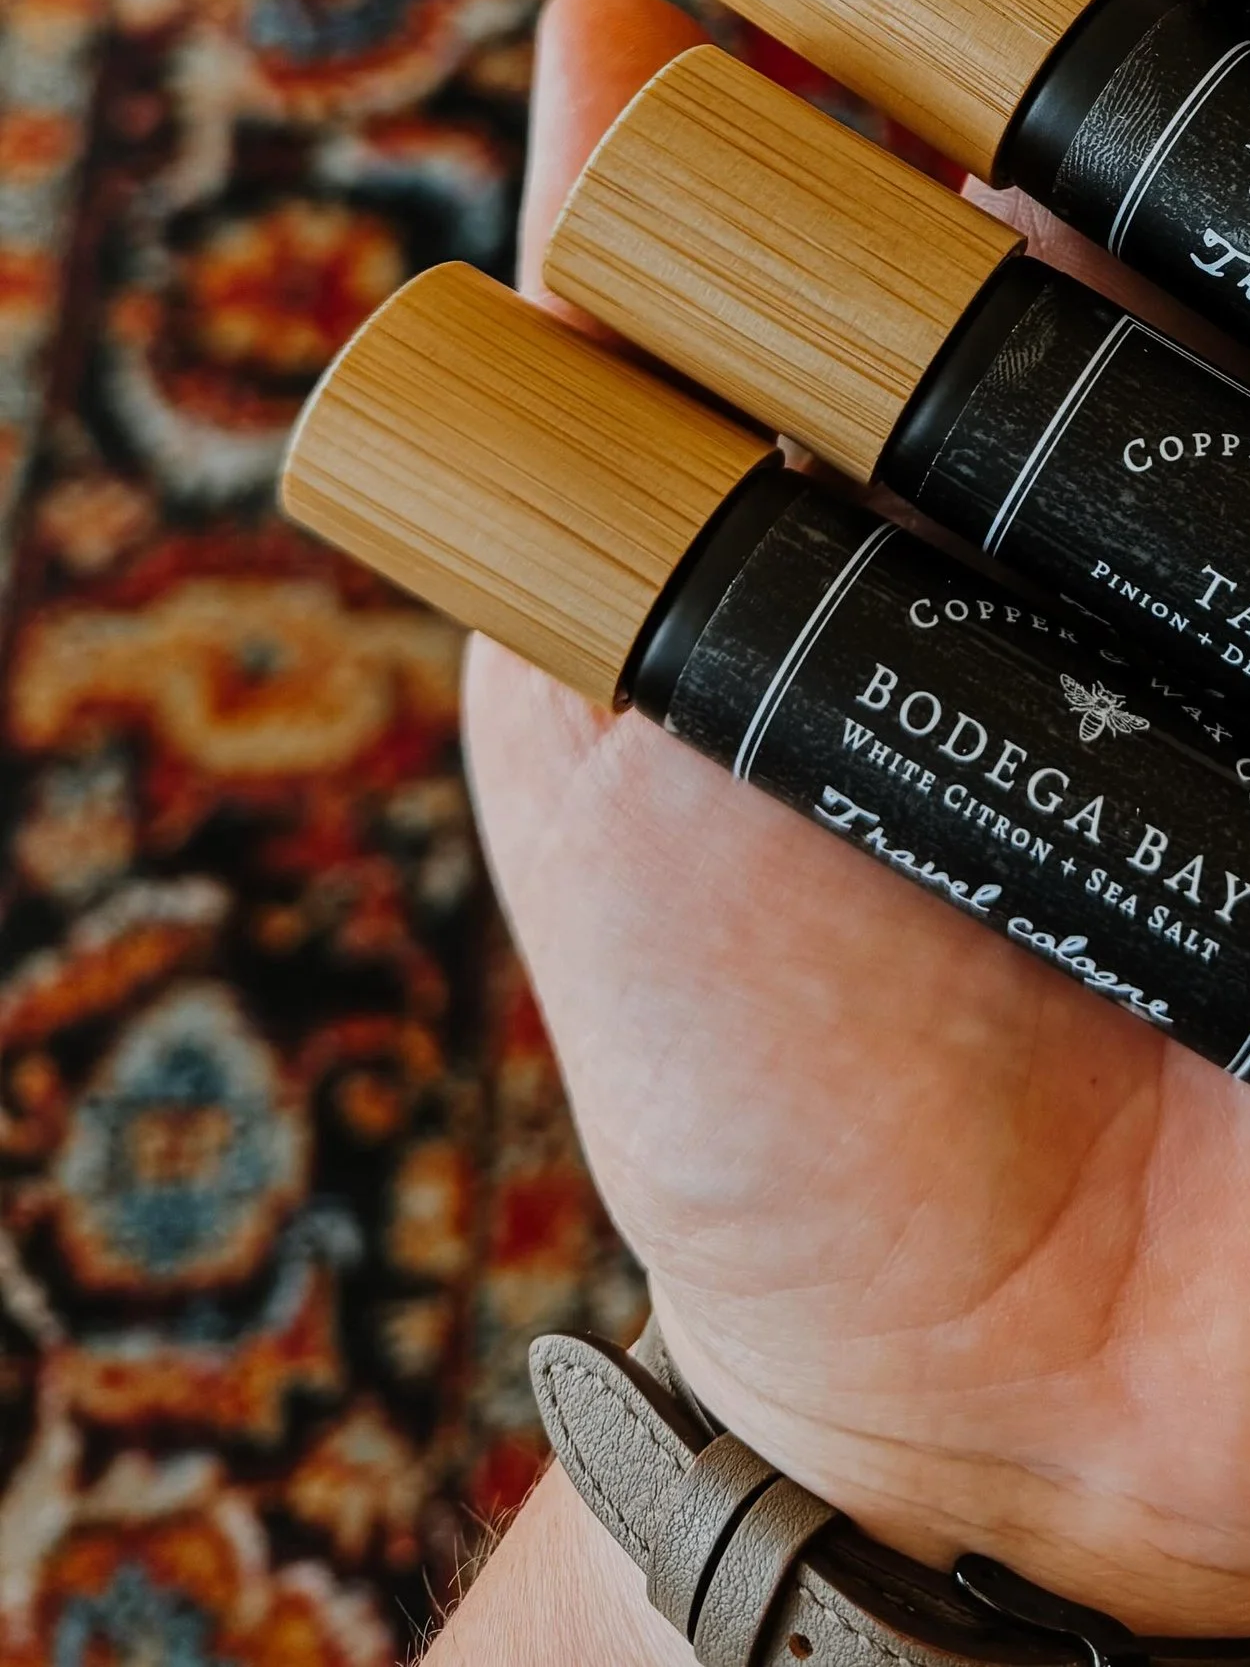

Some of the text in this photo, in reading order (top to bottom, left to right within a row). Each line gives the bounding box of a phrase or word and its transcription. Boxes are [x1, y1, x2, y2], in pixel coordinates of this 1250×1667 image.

[908, 598, 1079, 644] COPPER
[1090, 560, 1190, 633] PINION
[842, 717, 934, 791] WHITE
[944, 783, 1054, 865] CITRON
[1085, 868, 1139, 918] SEA
[1147, 905, 1220, 963] SALT
[855, 663, 1105, 845] BODEGA
[814, 784, 1174, 1023] Travel cologne
